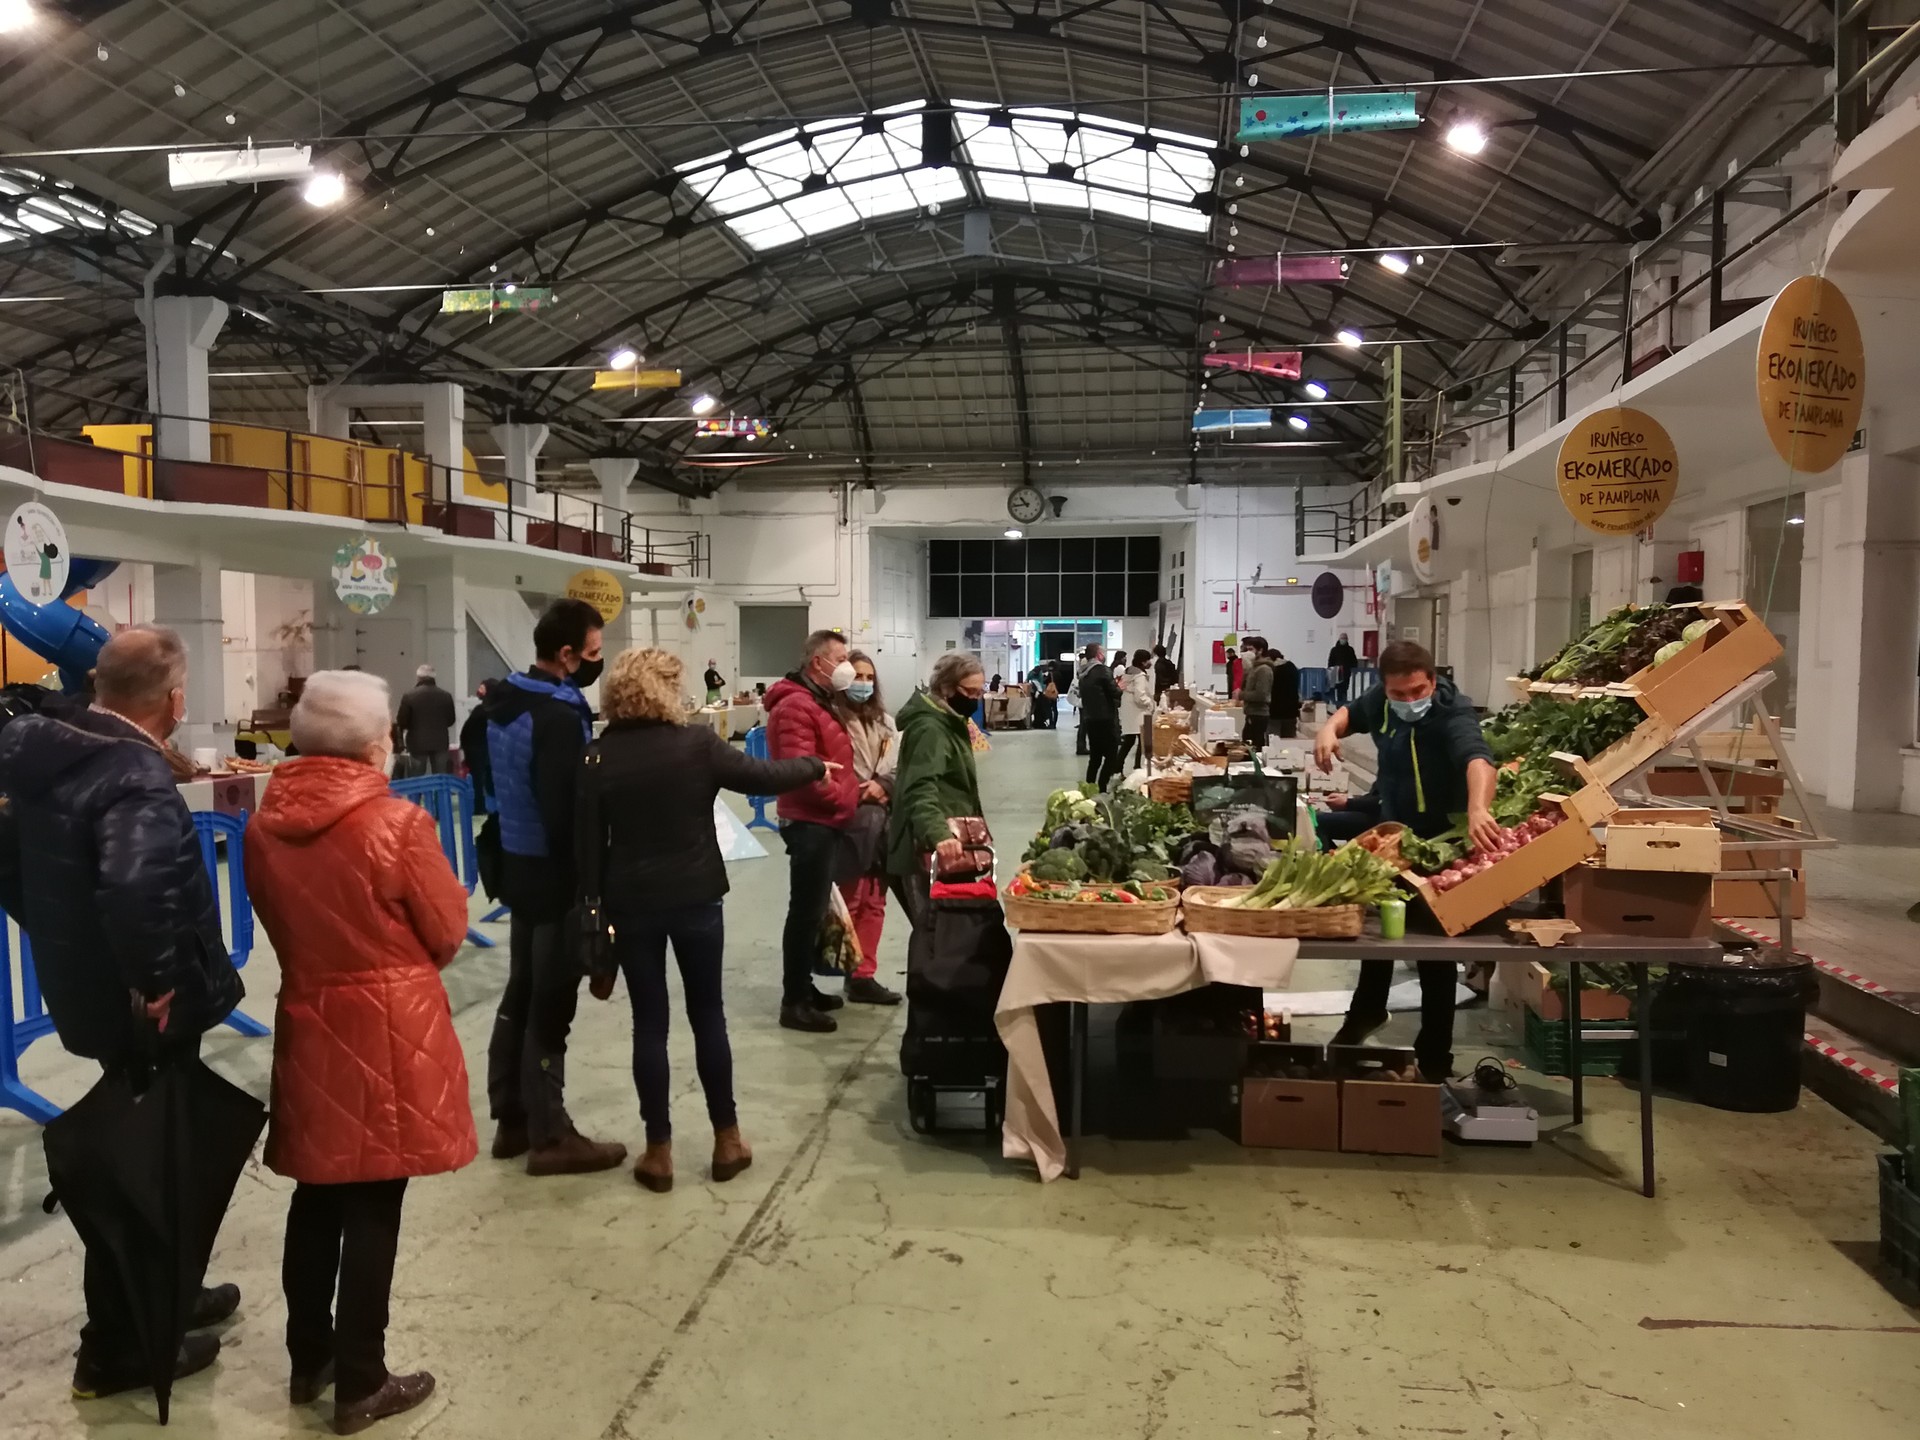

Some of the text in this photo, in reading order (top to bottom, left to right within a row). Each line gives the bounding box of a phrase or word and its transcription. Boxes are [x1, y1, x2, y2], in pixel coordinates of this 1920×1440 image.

[1792, 313, 1838, 343] IRUÑEKO
[1768, 352, 1857, 394] EKOMERCADO
[1778, 401, 1792, 419] DE
[1590, 426, 1645, 448] IRUÑEKO
[1563, 456, 1673, 480] EKOMERCADO
[1580, 489, 1661, 505] DE PAMPLONA
[568, 589, 621, 603] EKOMERCADO
